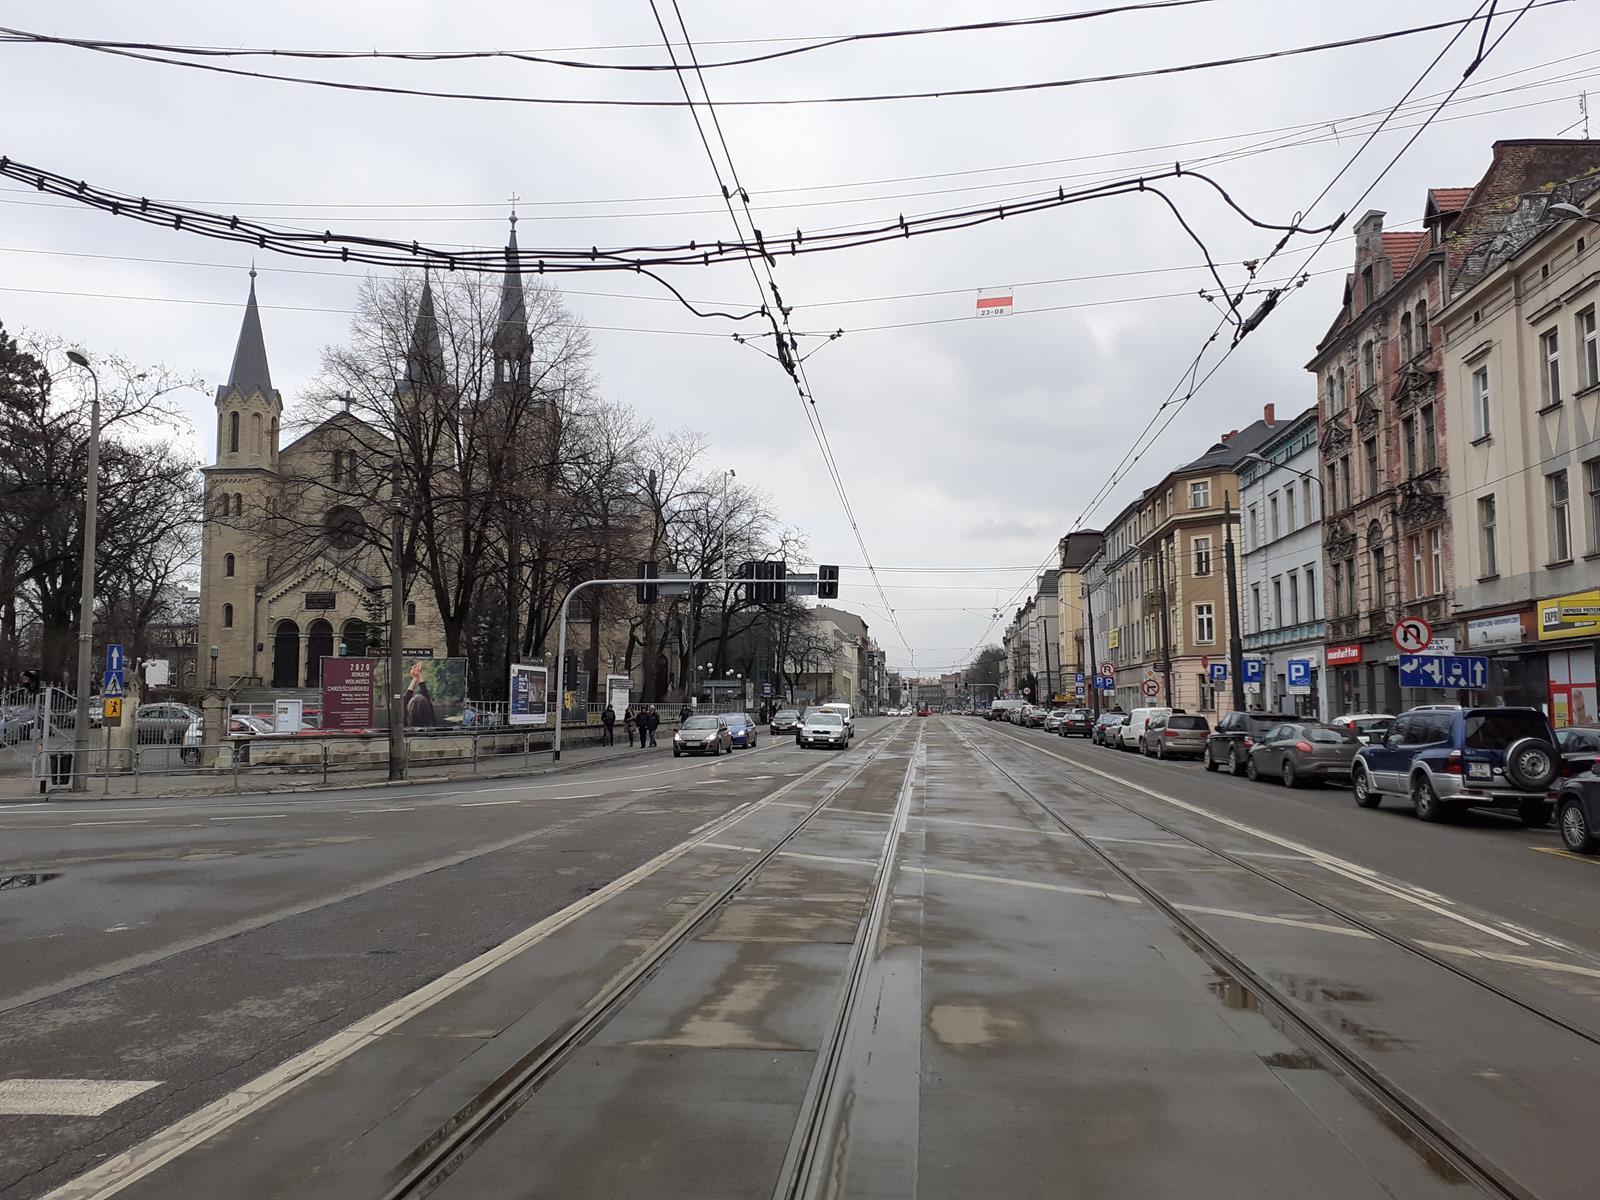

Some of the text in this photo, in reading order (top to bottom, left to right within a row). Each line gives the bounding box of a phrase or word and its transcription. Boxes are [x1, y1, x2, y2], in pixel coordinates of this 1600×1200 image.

[1327, 647, 1358, 660] manhattan
[350, 663, 370, 671] 2020
[1213, 665, 1224, 679] P
[1247, 662, 1259, 676] P
[1291, 664, 1304, 681] P
[1096, 676, 1103, 684] P
[1105, 679, 1113, 687] P
